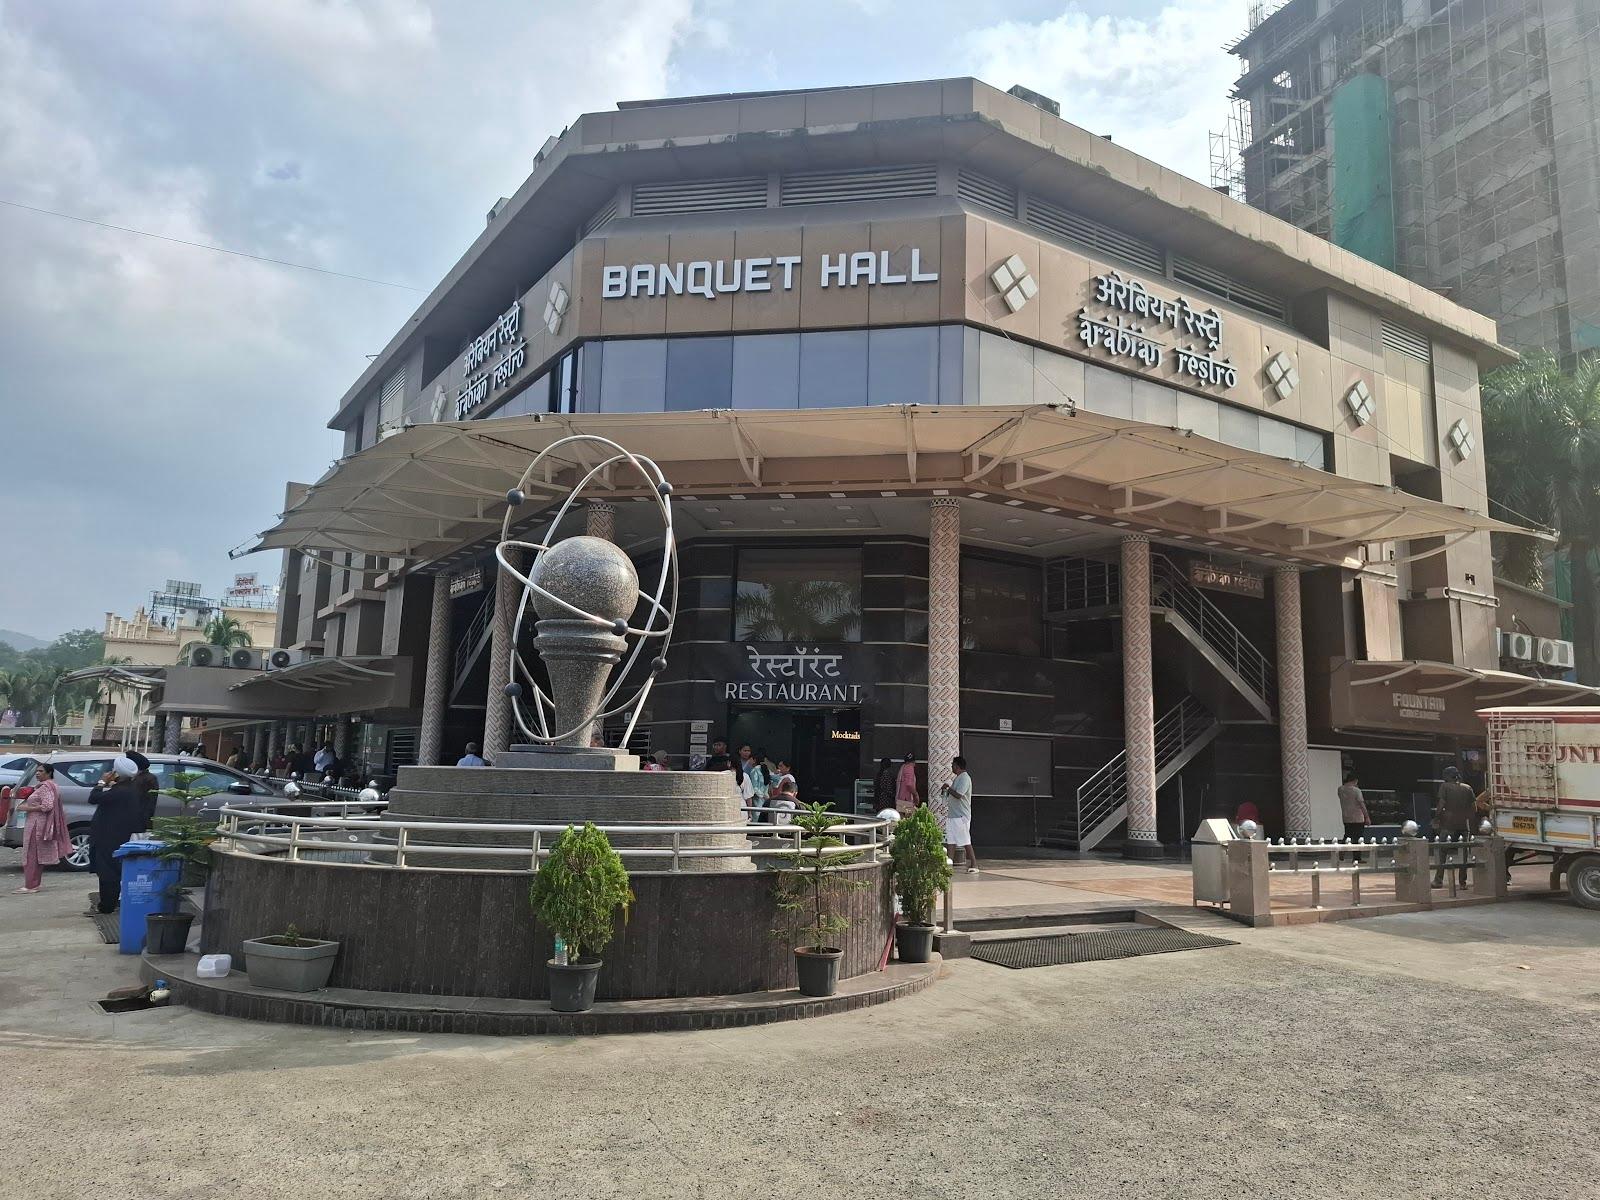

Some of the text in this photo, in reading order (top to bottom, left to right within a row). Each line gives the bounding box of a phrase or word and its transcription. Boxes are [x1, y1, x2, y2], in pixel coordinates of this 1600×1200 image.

[602, 248, 939, 299] BANQUET HALL
[1096, 271, 1225, 351] अरेबियन रेस्ट्रो
[463, 335, 498, 377] अरेबियन
[1078, 306, 1238, 388] arabian restro
[454, 337, 527, 421] arabian restro
[746, 645, 843, 679] रेस्टॉरंट
[725, 682, 862, 702] RESTAURANT
[831, 730, 861, 740] Mocktails
